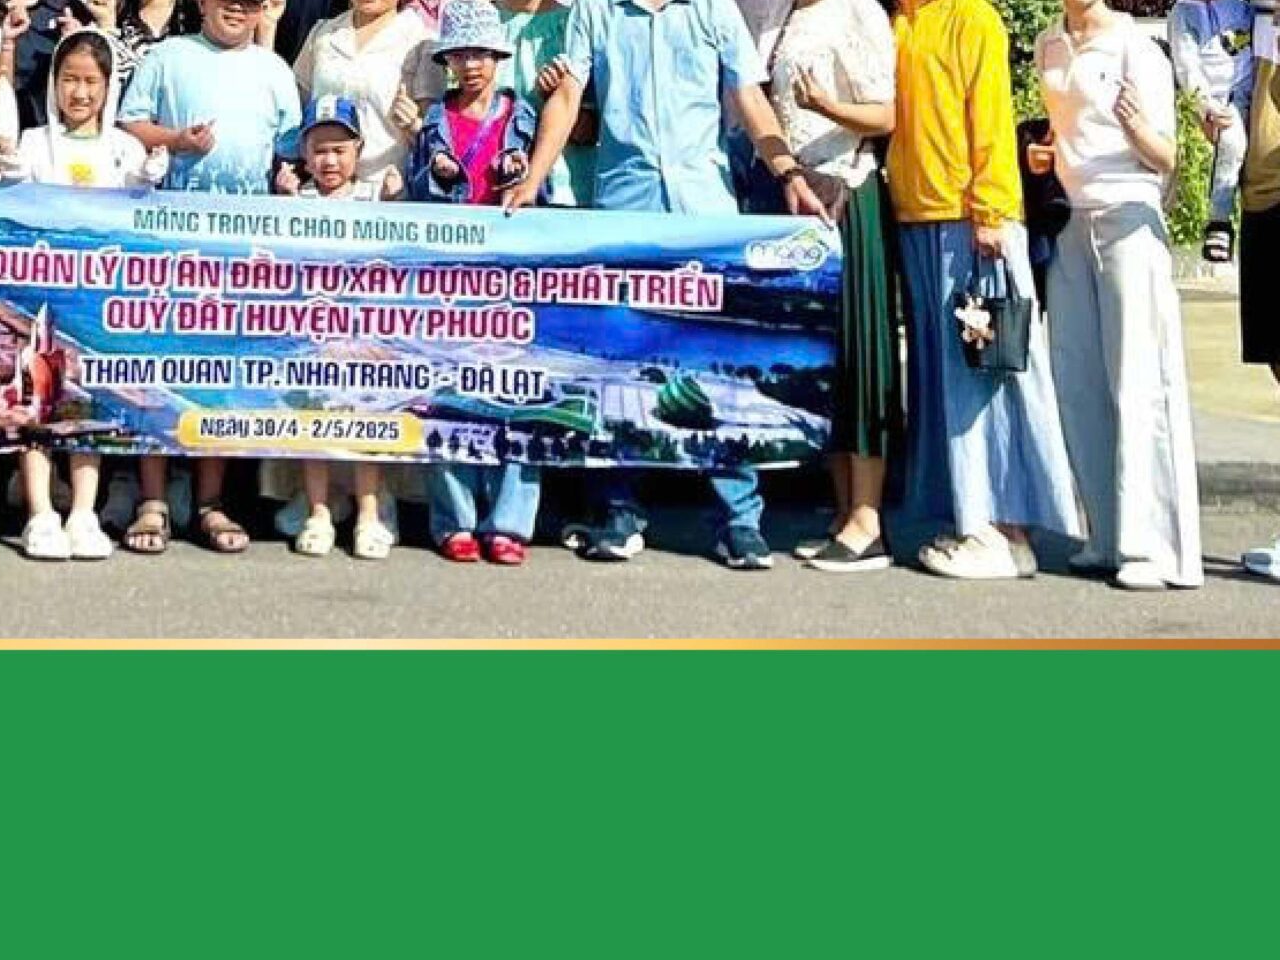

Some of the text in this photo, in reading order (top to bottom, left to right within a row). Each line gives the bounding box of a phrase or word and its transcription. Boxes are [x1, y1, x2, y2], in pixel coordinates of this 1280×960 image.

[207, 212, 282, 237] TRAVEL
[84, 248, 120, 286] LÝ
[176, 251, 220, 289] ÁN
[346, 261, 409, 294] XÂY
[512, 271, 531, 295] &
[540, 265, 620, 302] PHÁT
[360, 306, 418, 335] TUY
[82, 359, 155, 384] THAM
[162, 359, 231, 384] QUAN
[243, 360, 280, 386] TP.
[287, 361, 339, 387] NHA
[346, 363, 430, 389] TRANG
[254, 418, 299, 438] 30/4
[311, 419, 400, 440] 2/5/2025
